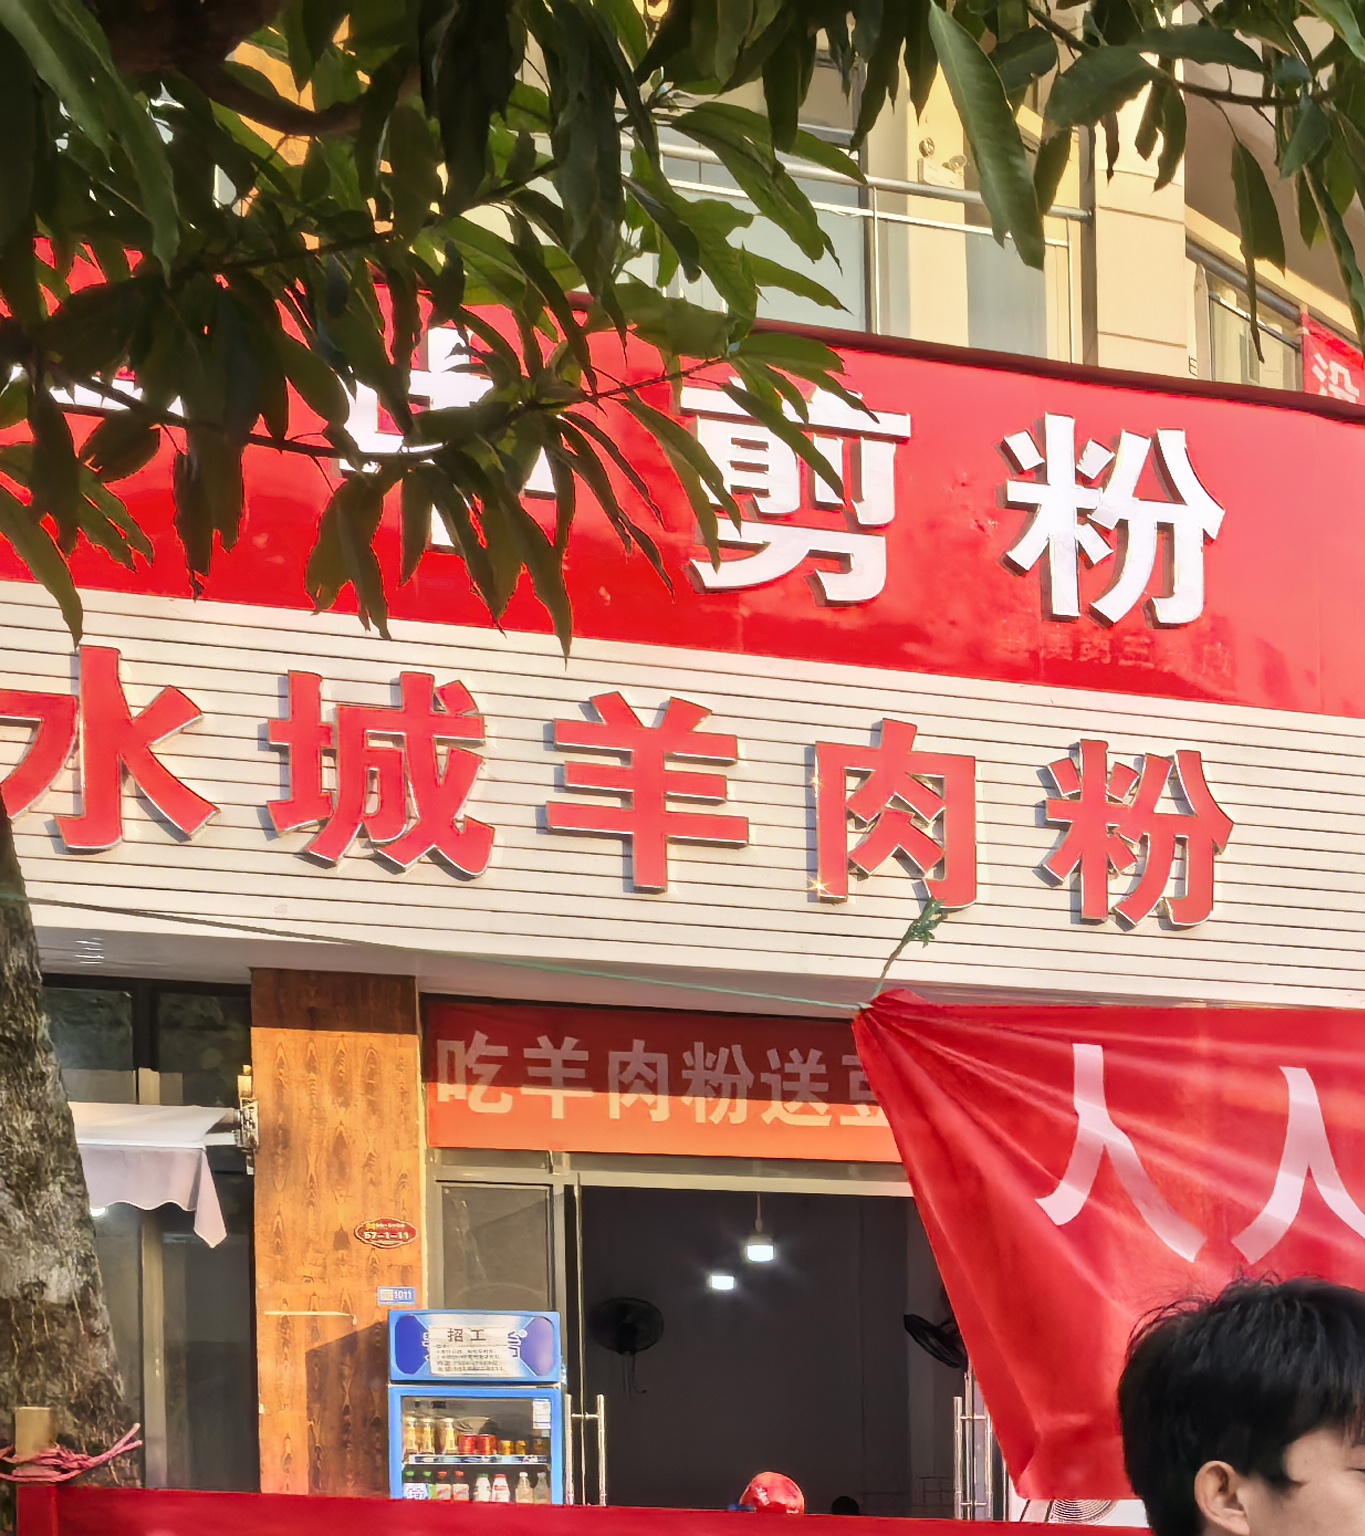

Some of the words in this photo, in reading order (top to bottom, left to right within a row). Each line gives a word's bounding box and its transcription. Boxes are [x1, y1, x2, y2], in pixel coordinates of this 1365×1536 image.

[0, 644, 1235, 929] 水城羊肉粉
[447, 1328, 486, 1342] 招工
